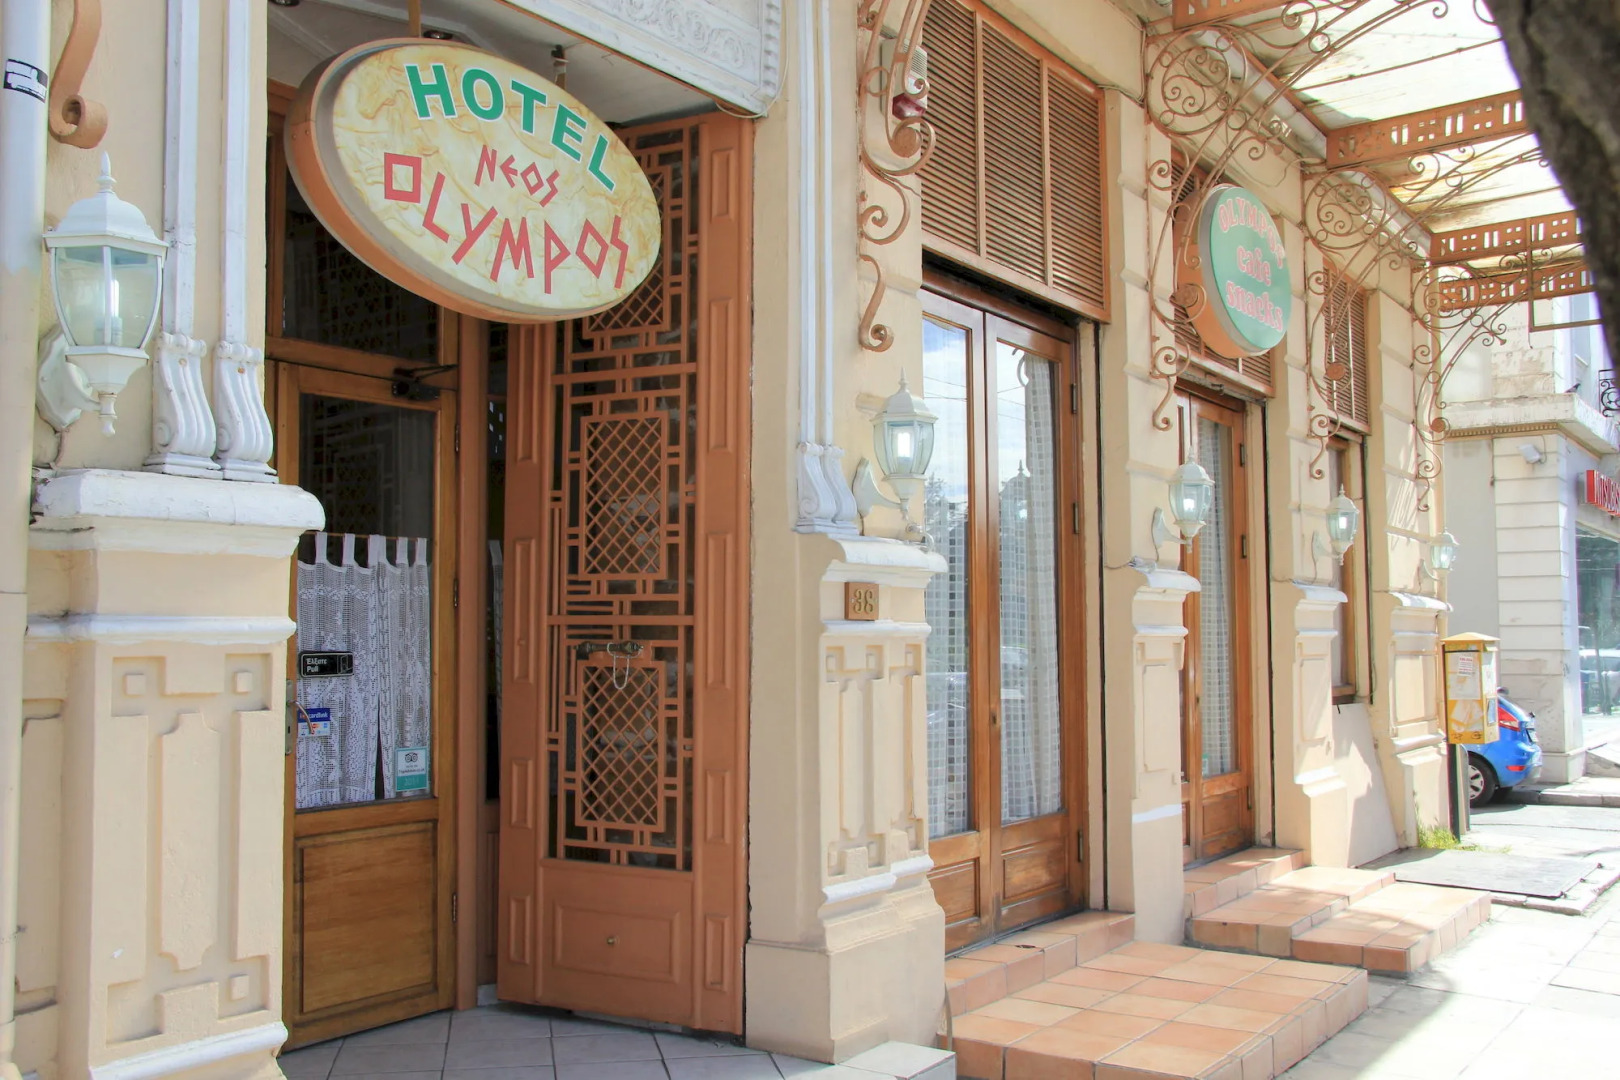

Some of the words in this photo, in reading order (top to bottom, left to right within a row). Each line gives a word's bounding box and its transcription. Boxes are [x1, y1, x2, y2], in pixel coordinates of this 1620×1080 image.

[404, 62, 616, 194] HOTEL
[383, 151, 629, 295] OLYMPOS
[1226, 280, 1282, 331] snacks
[306, 665, 319, 673] Pull
